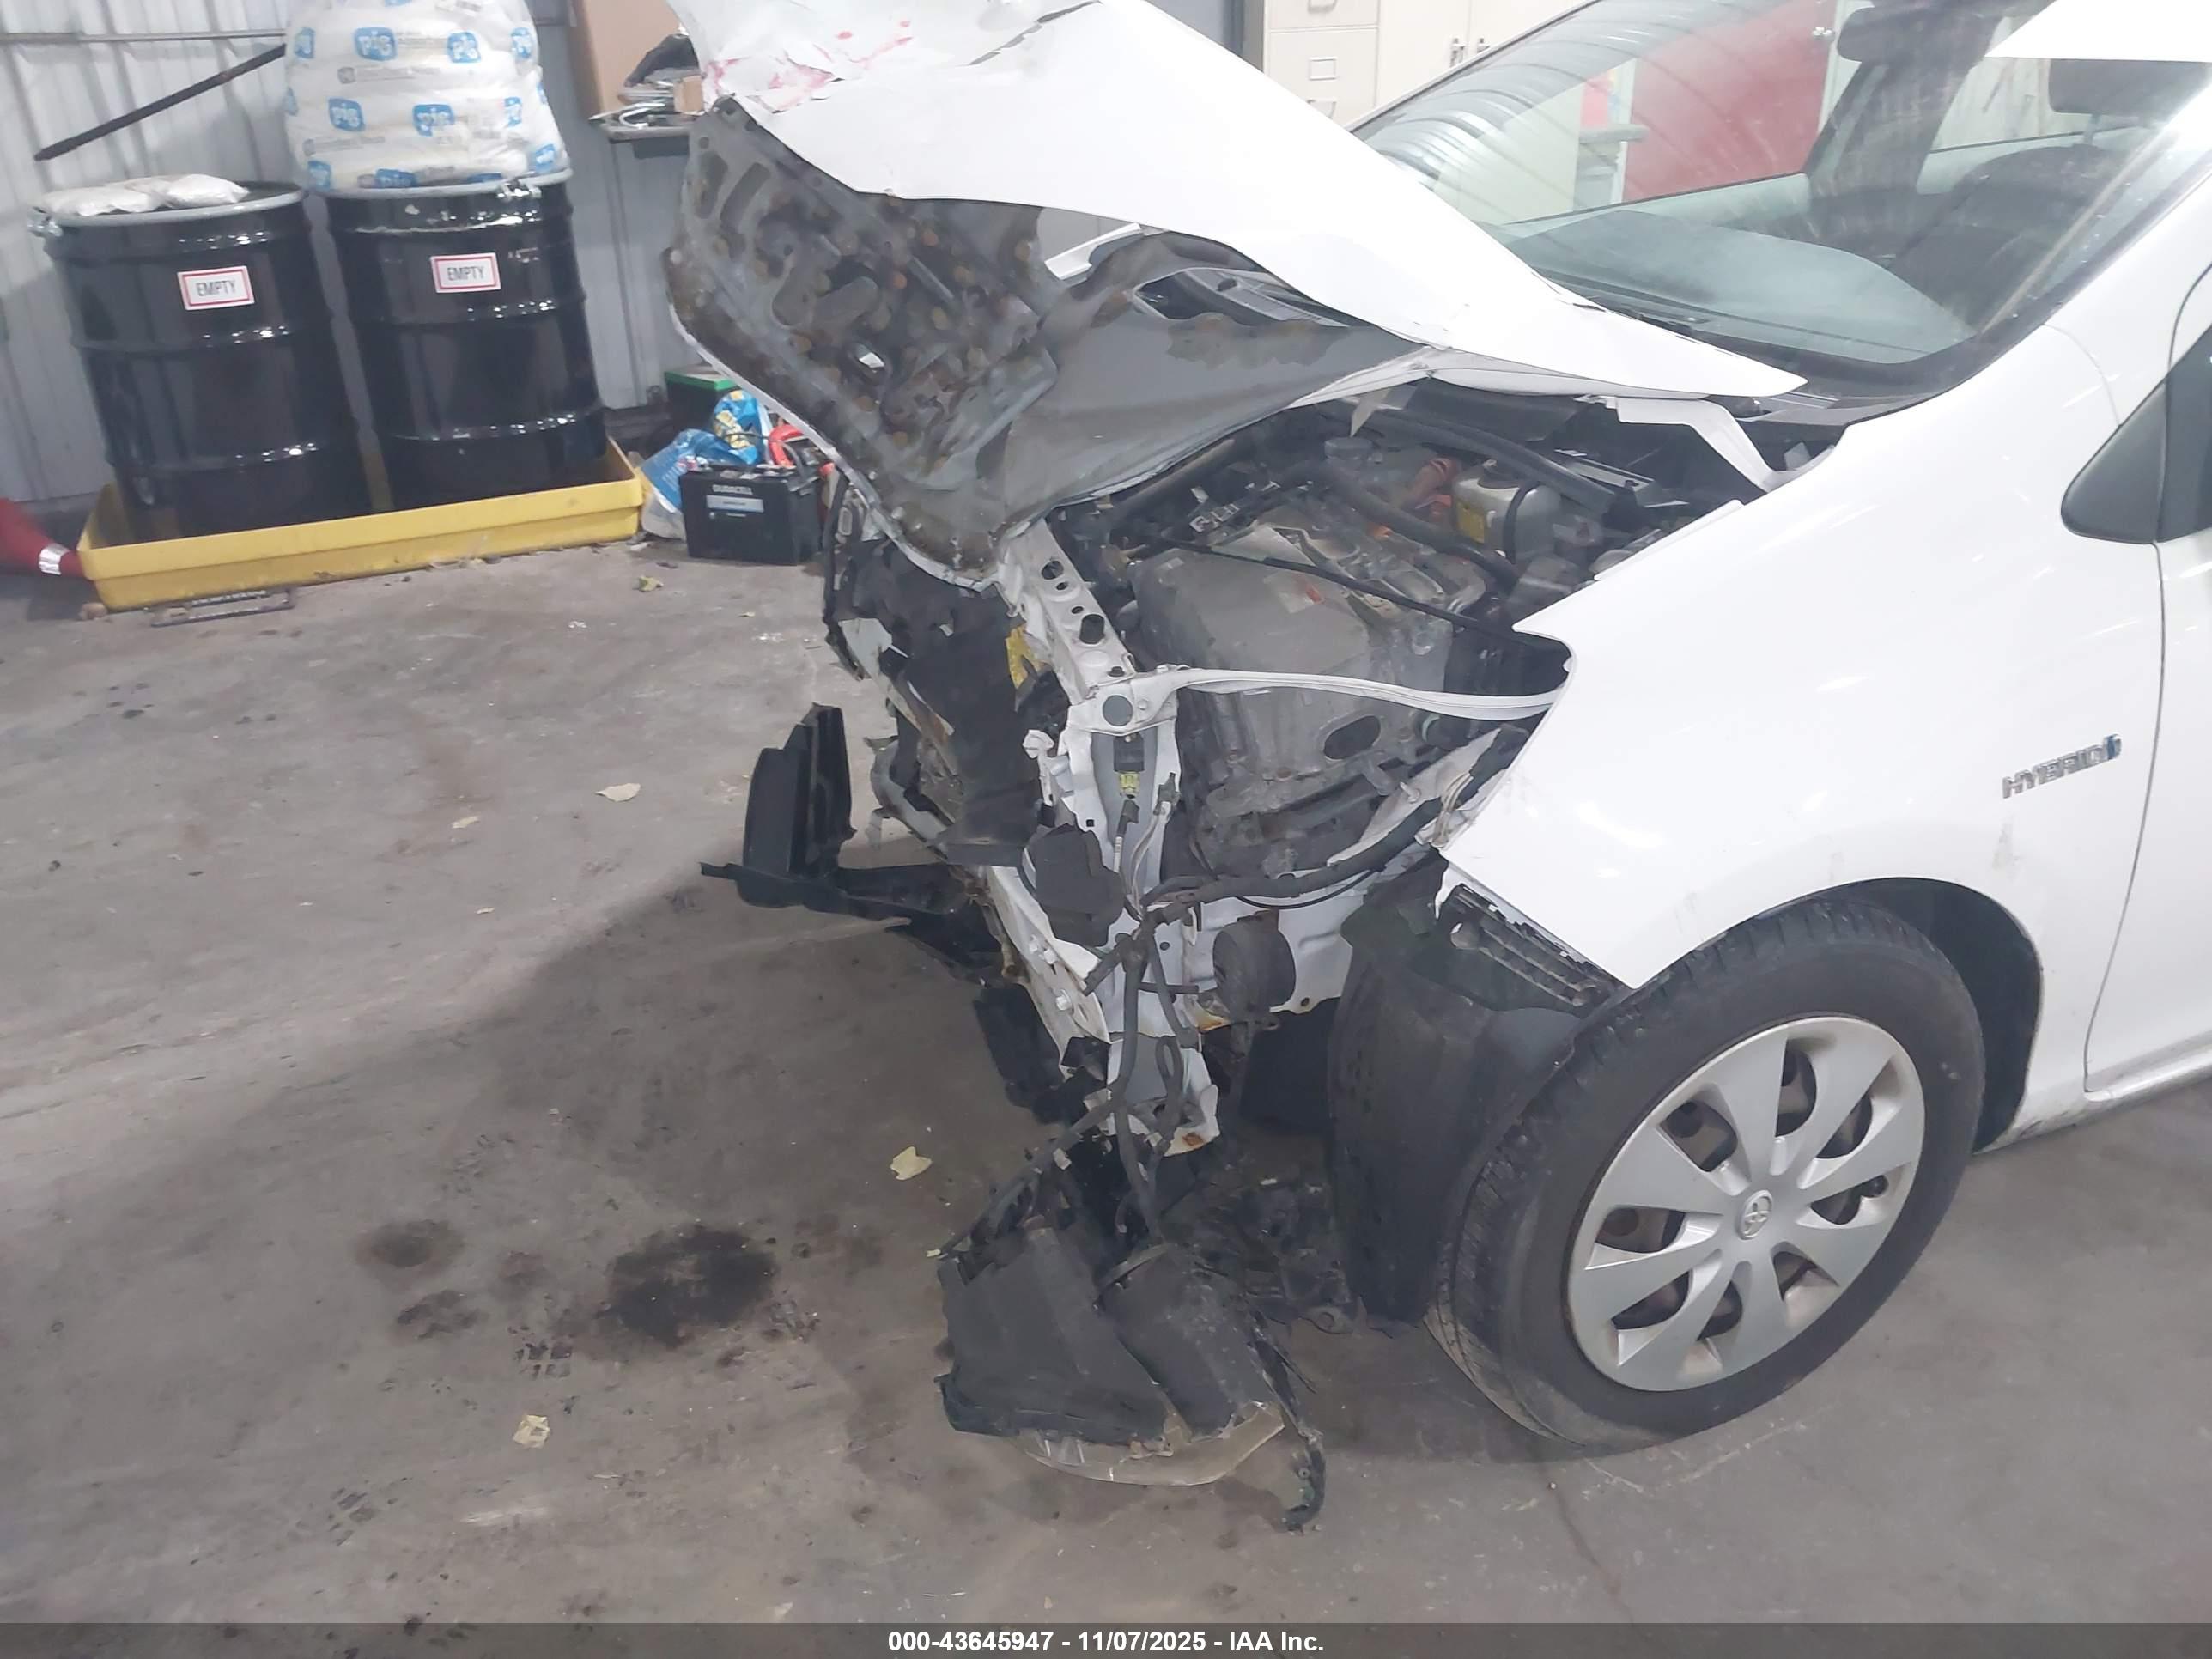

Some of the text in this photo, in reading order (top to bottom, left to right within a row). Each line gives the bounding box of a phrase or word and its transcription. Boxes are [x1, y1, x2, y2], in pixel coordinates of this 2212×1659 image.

[447, 266, 484, 281] EMPTY
[196, 279, 235, 296] EMPTY
[2002, 744, 2105, 799] HYBRID
